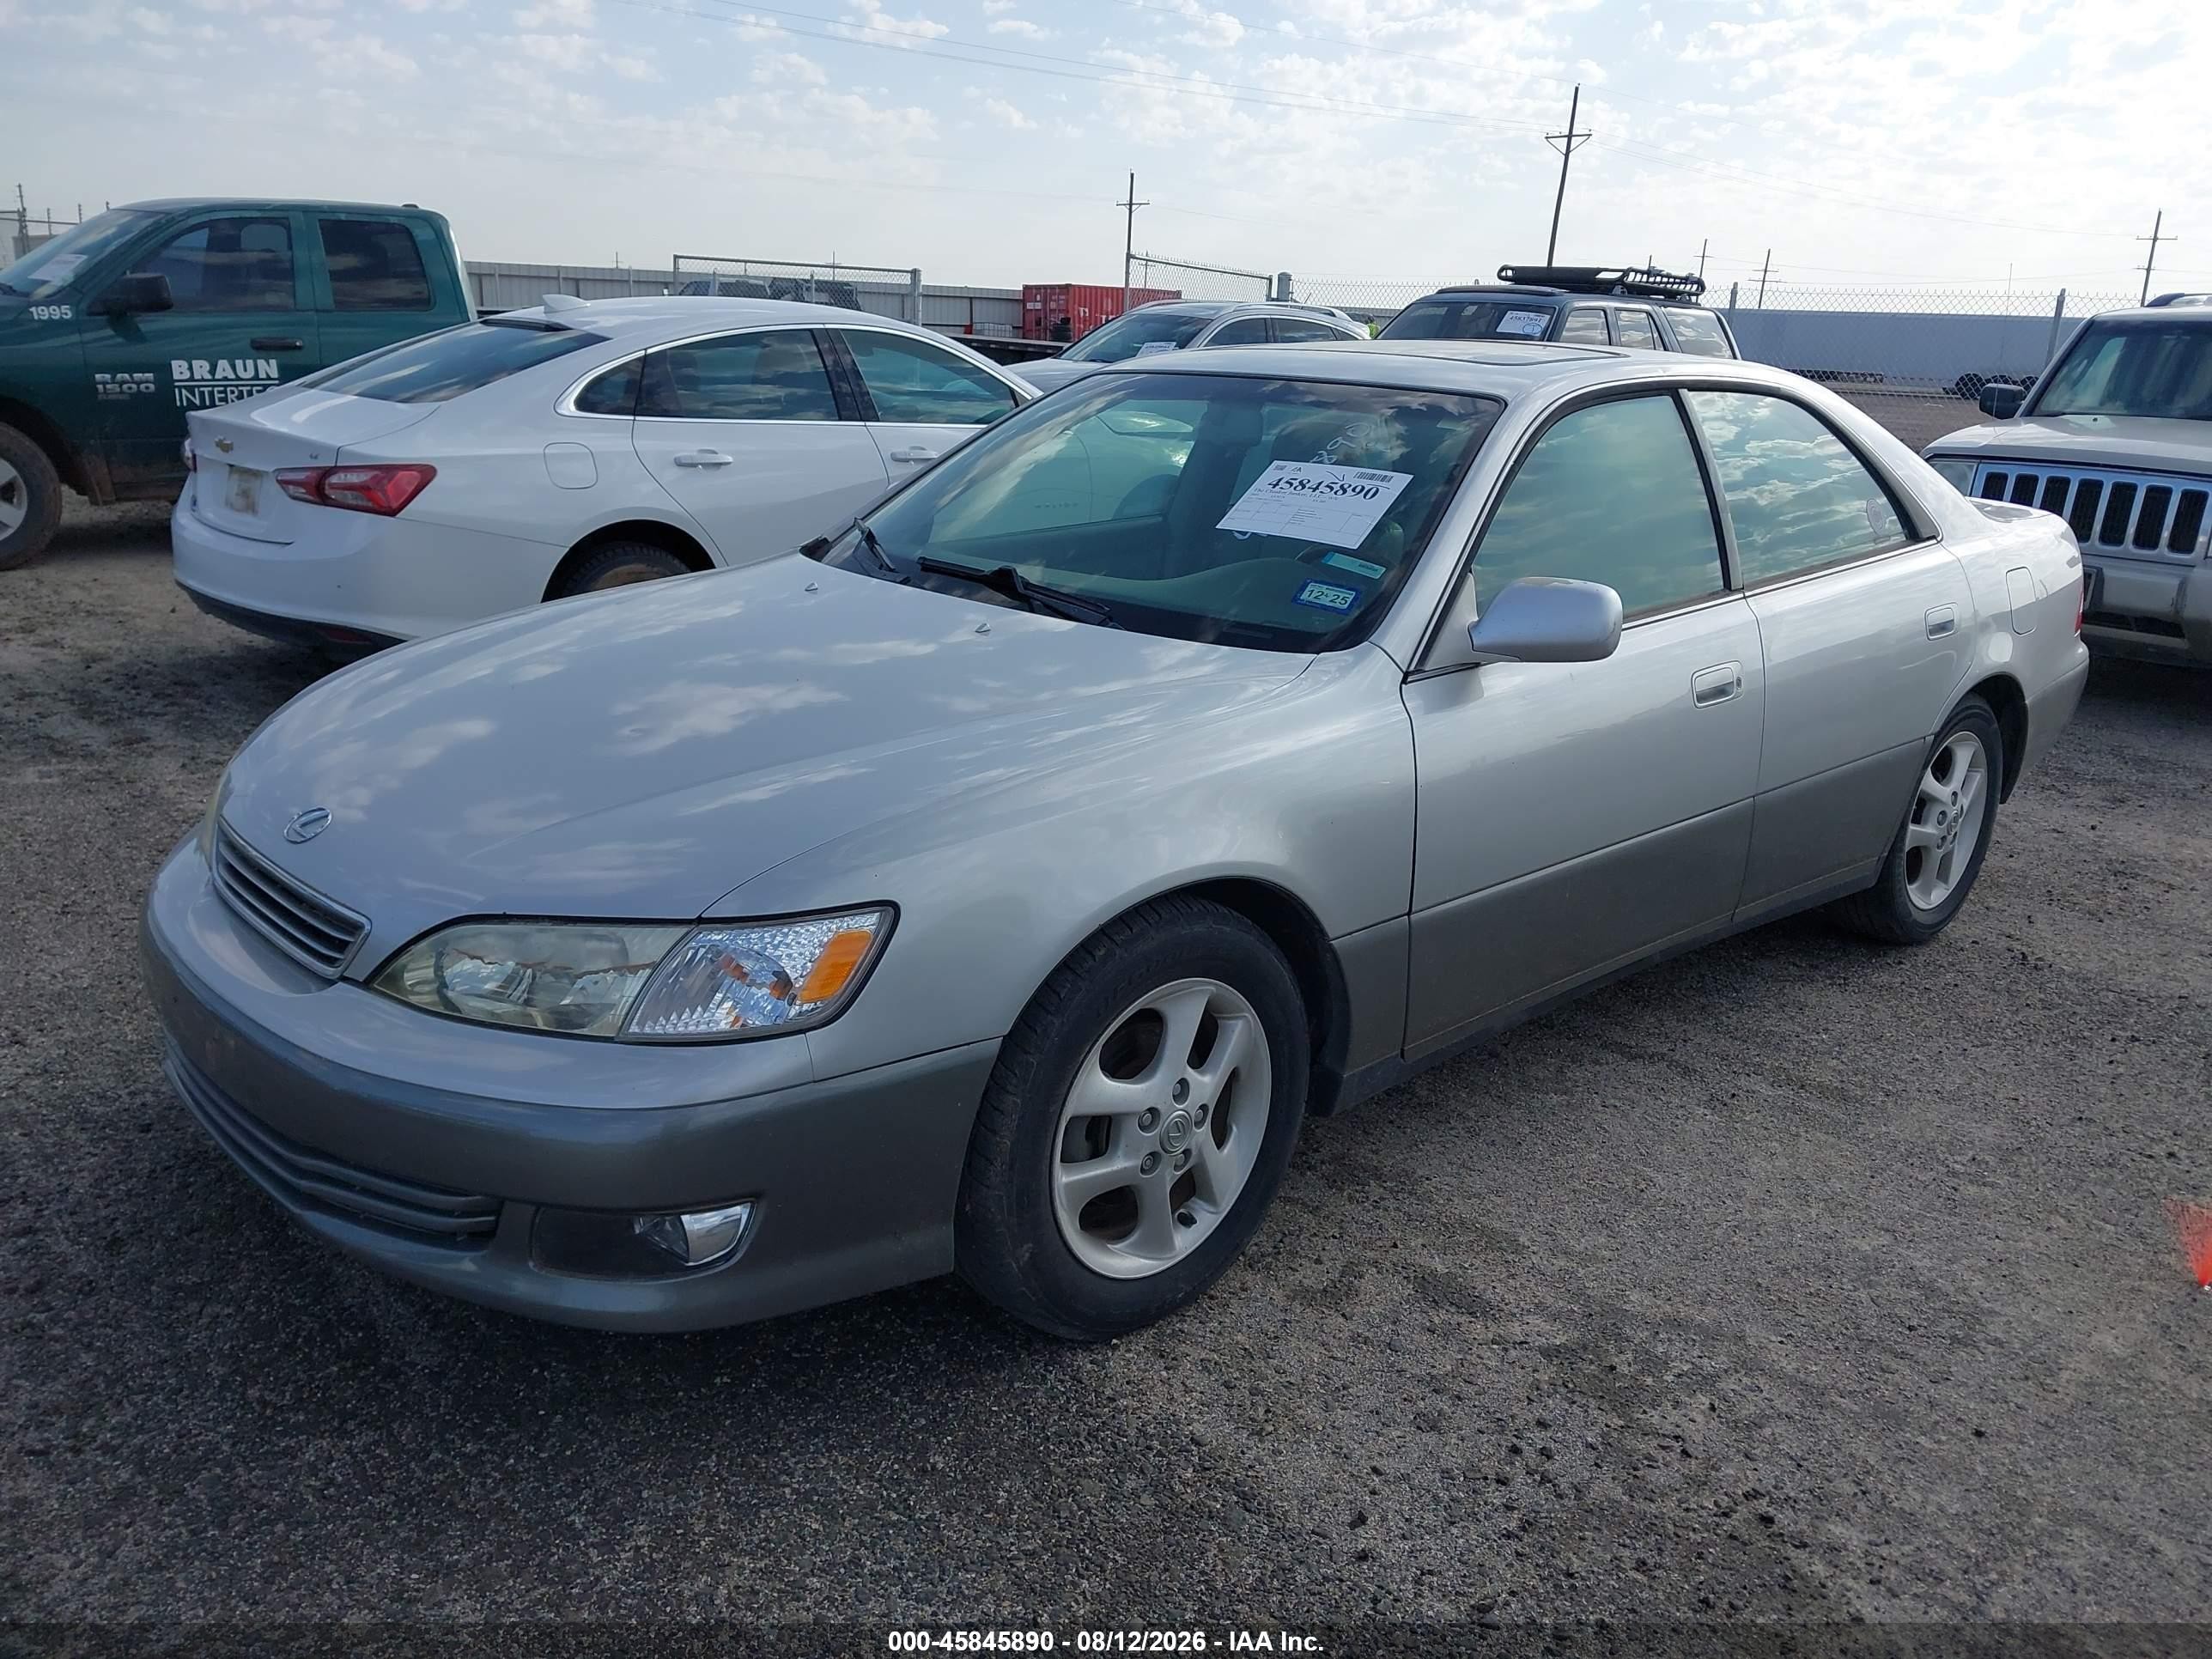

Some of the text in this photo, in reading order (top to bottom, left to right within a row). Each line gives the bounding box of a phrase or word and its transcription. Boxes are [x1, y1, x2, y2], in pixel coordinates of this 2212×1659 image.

[29, 305, 73, 320] 1995
[171, 359, 279, 380] BRAUN
[94, 373, 154, 384] RAM
[95, 382, 155, 393] 1500
[1267, 476, 1380, 501] 45845890
[1307, 588, 1325, 600] 12
[1328, 593, 1351, 605] 25
